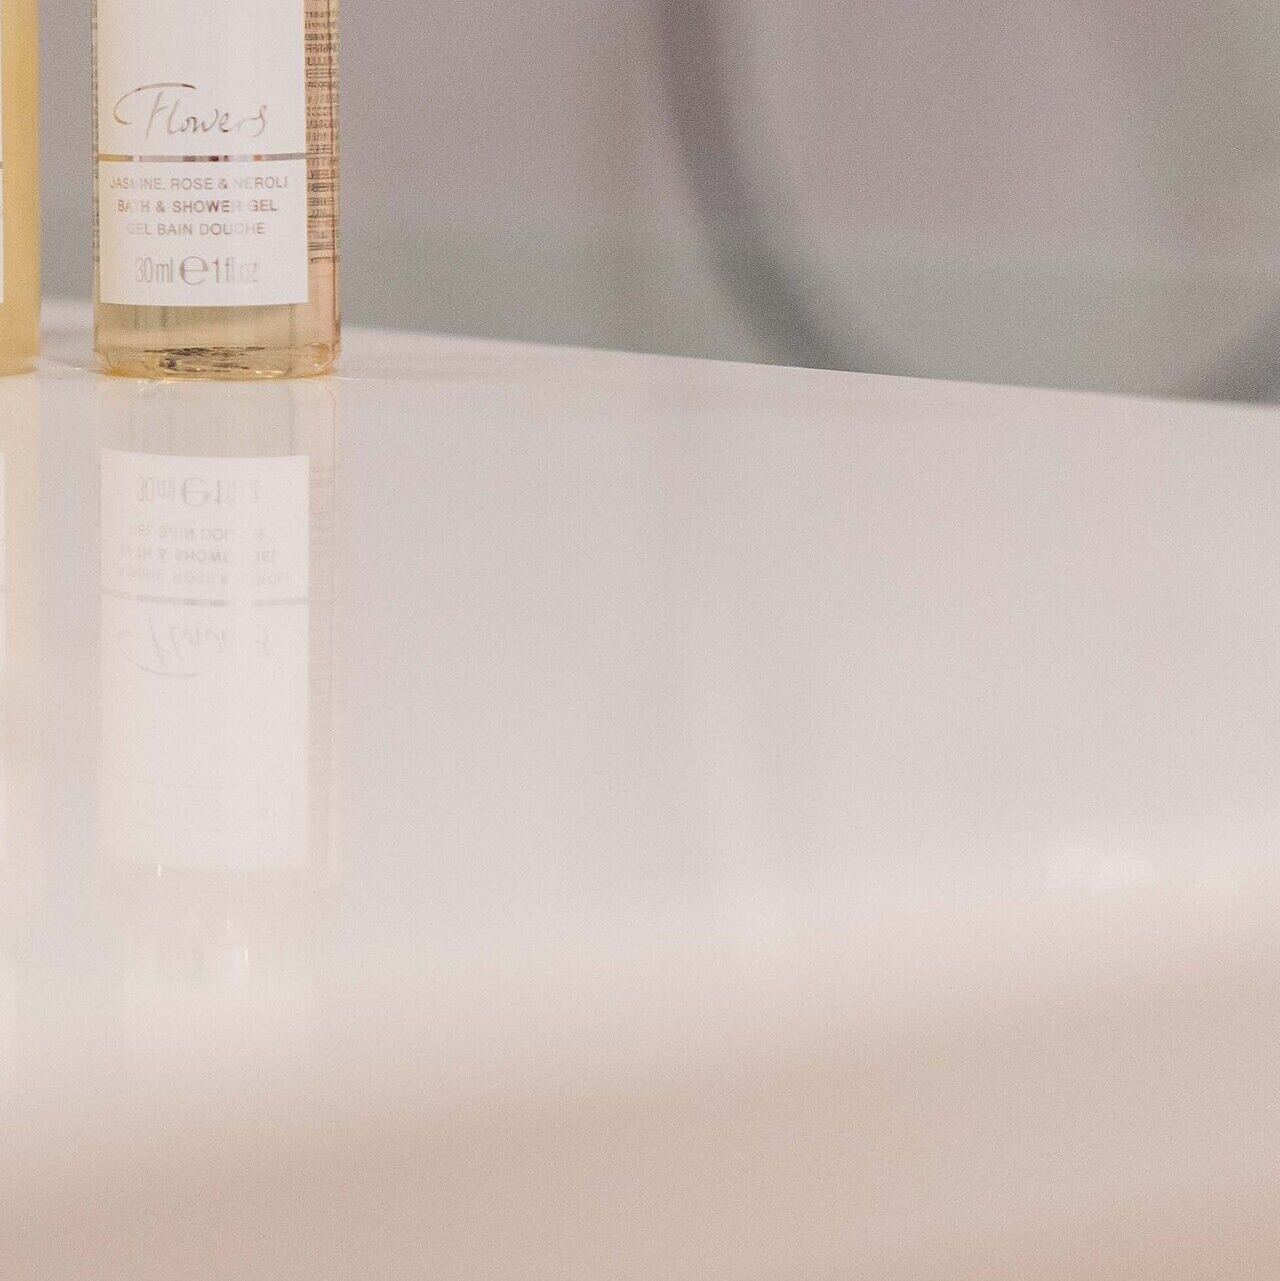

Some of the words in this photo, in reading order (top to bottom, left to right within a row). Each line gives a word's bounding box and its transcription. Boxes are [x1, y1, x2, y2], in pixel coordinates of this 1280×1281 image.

[113, 82, 268, 140] Flowers
[170, 177, 213, 190] ROSE
[217, 177, 228, 189] &
[117, 199, 150, 213] BAH
[155, 200, 166, 213] &
[172, 200, 243, 213] SHOWER
[251, 200, 278, 212] GEL
[127, 222, 152, 235] GEL
[157, 223, 193, 235] BAIN
[199, 222, 265, 235] DOUCHE
